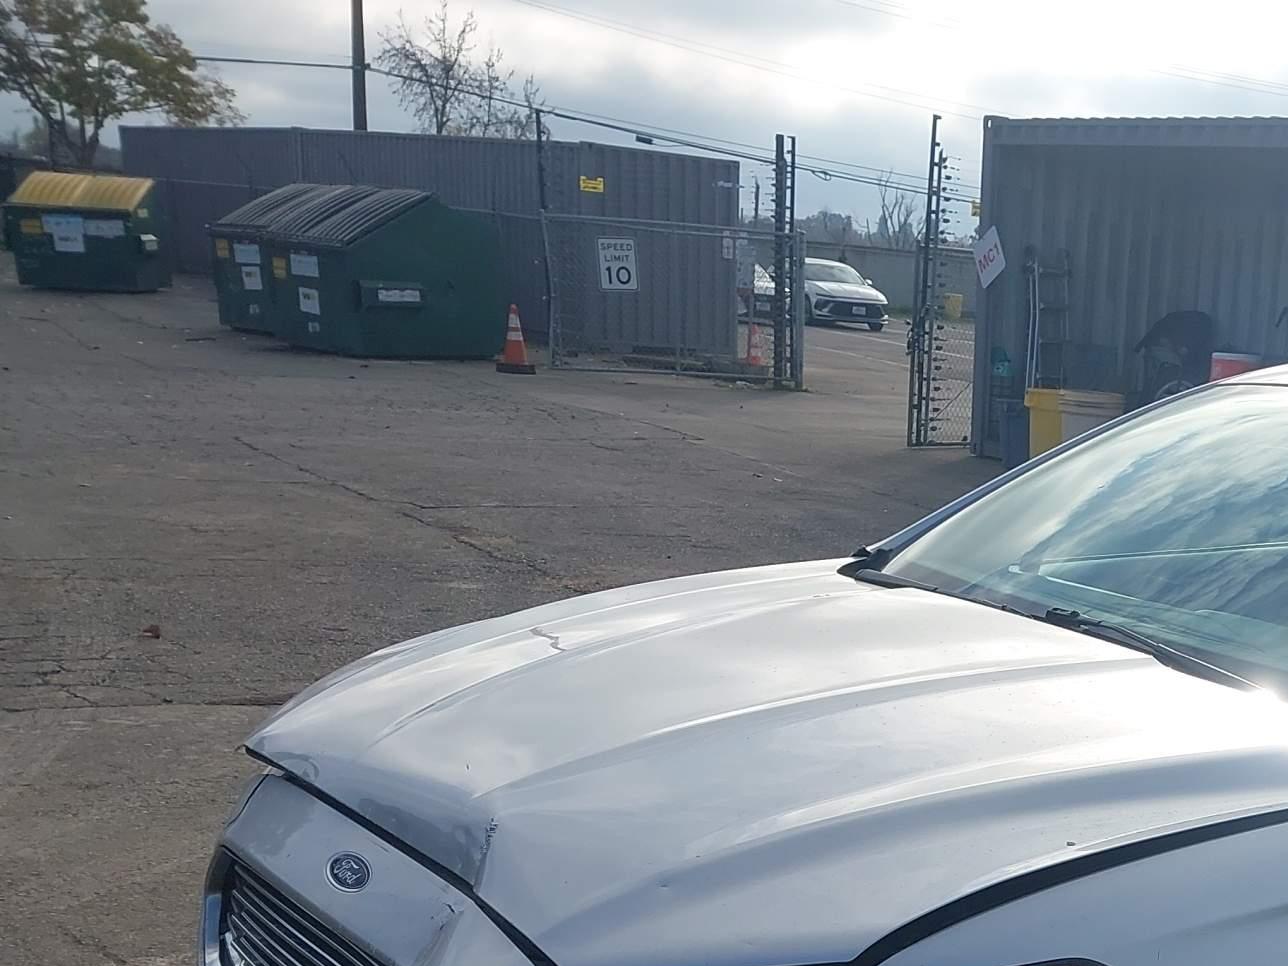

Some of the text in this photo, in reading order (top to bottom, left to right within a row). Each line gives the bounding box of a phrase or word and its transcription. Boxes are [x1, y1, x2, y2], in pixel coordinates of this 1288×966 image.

[600, 242, 633, 252] SPEED
[604, 254, 630, 263] LIMIT
[605, 265, 632, 285] 10
[333, 858, 362, 885] Ford
